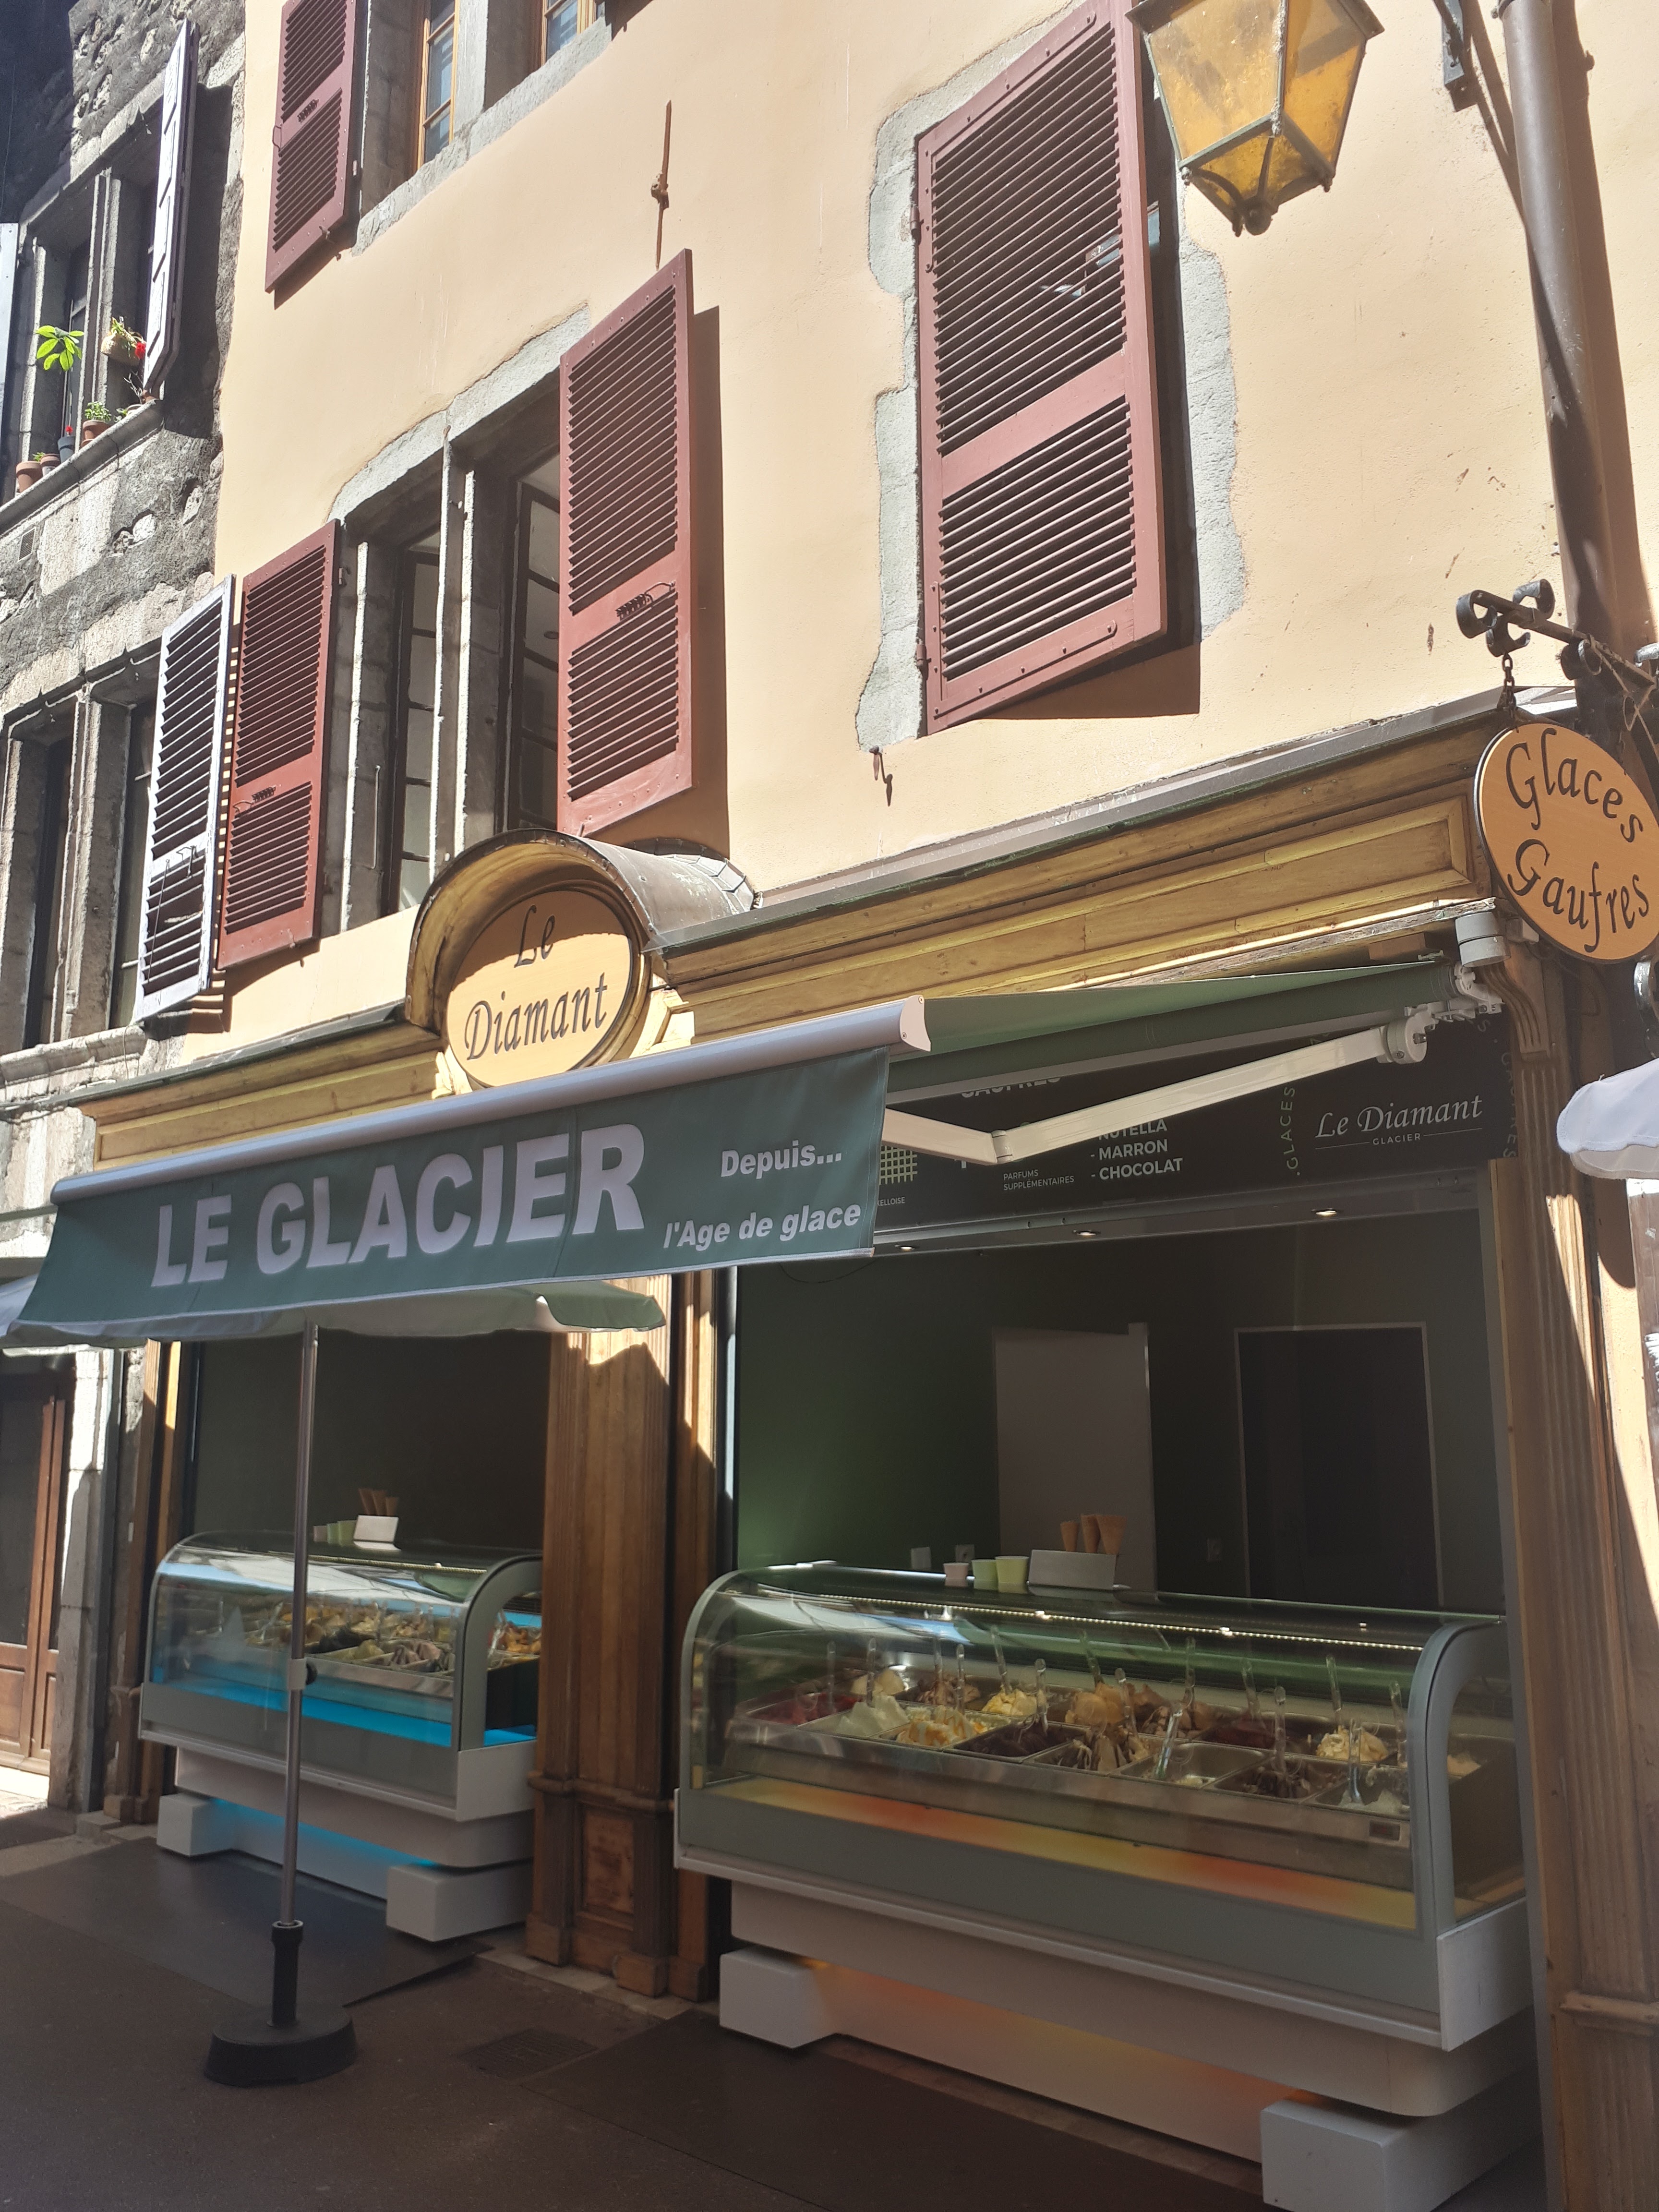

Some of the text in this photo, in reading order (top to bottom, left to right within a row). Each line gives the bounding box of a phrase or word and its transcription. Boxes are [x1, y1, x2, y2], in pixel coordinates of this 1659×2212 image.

[1506, 728, 1644, 843] Glaces
[1507, 839, 1649, 953] Gaufres
[514, 904, 556, 968] Le
[464, 972, 608, 1060] Diamant
[1280, 1087, 1298, 1169] GLACES
[1315, 1095, 1483, 1138] Le Diamant
[720, 1140, 842, 1179] Depuis...
[1098, 1139, 1168, 1160] MARRON
[1372, 1133, 1421, 1145] GLACIER
[1003, 1169, 1039, 1180] PARFUMS
[1003, 1175, 1075, 1190] SUPPLÉMENTAIRES
[1099, 1157, 1183, 1180] CHOCOLAT
[150, 1123, 645, 1287] LE GLACIER
[738, 1212, 773, 1239] de
[780, 1203, 862, 1241] glace
